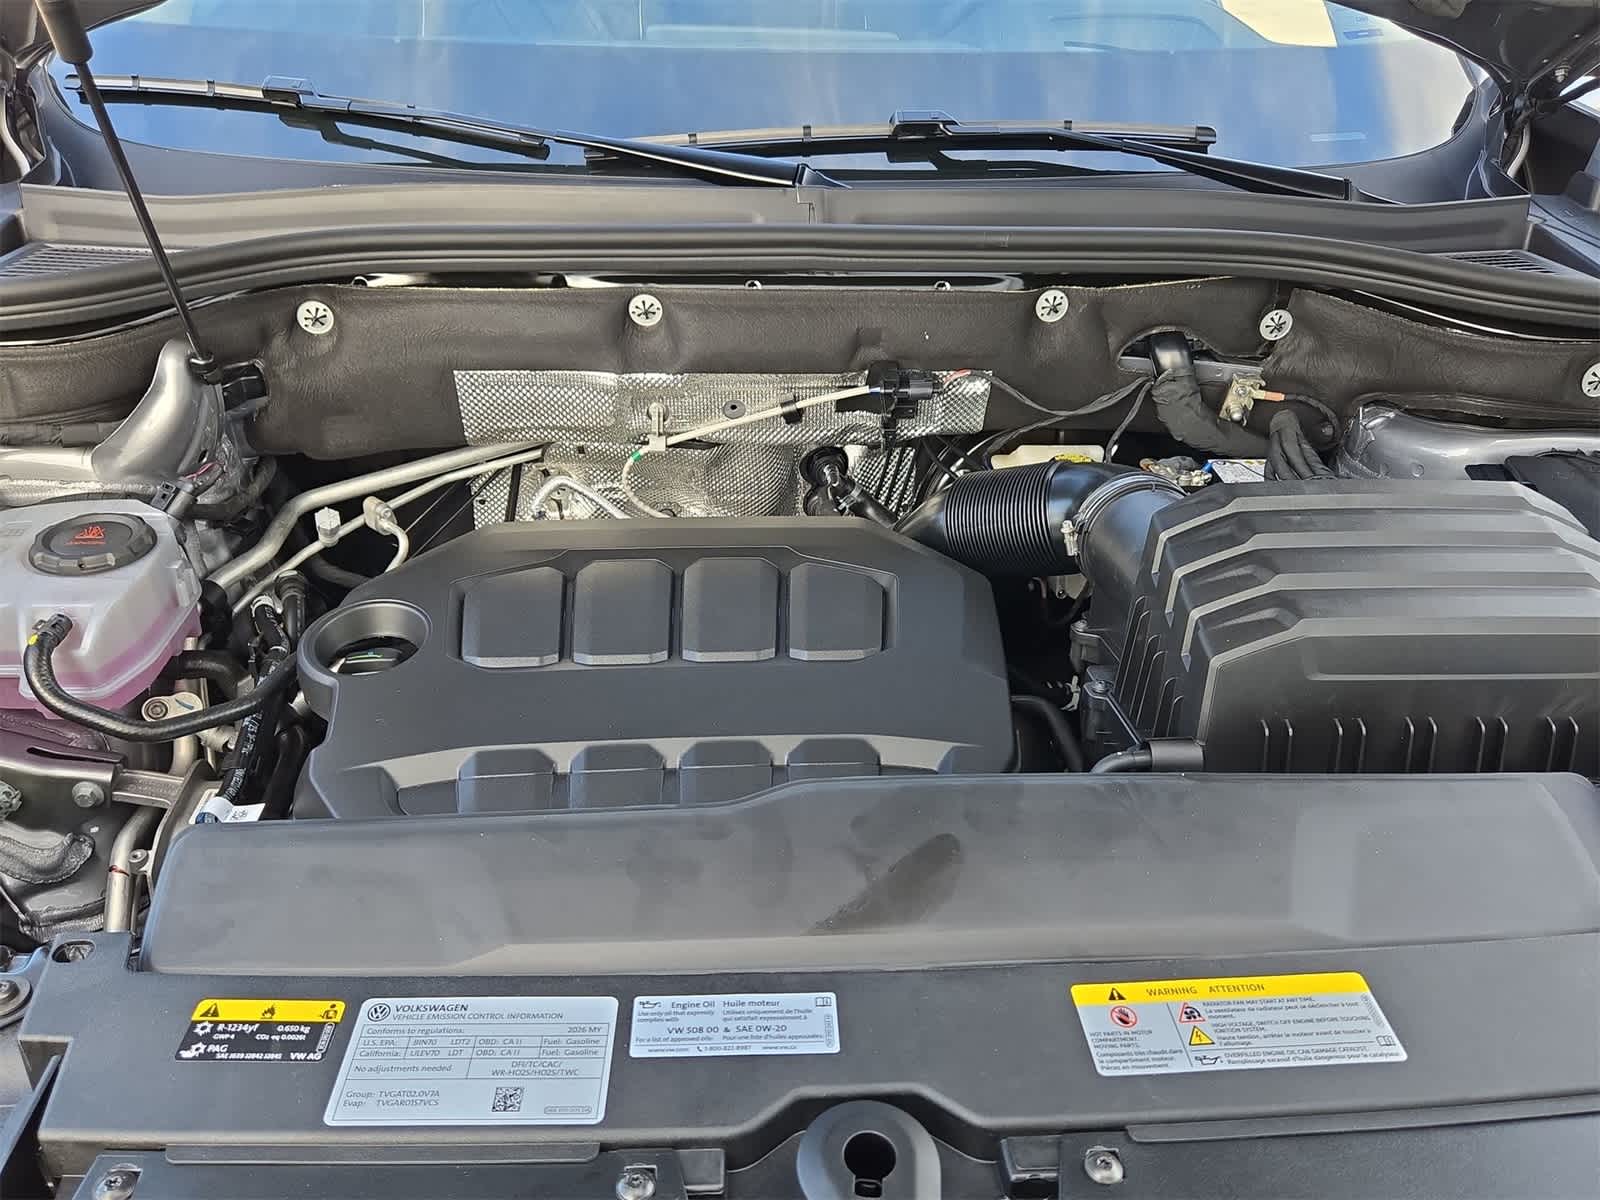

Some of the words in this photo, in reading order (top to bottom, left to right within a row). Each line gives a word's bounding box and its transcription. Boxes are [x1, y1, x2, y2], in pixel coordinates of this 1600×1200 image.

[1146, 986, 1197, 997] WARNING
[1208, 983, 1265, 994] ATTENTION
[395, 1003, 469, 1013] VOLKSWAGEN
[671, 1001, 701, 1010] Engine
[702, 1000, 716, 1008] Oil
[723, 1000, 746, 1008] Huile
[748, 999, 780, 1008] moteur
[392, 1013, 426, 1021] VEHICLE
[426, 1013, 465, 1021] EMISSION
[467, 1012, 504, 1020] CONTROL
[507, 1012, 563, 1020] INFORMATION
[216, 1023, 260, 1034] R-1234yf
[300, 1024, 311, 1034] kg
[366, 1026, 405, 1036] Conforms
[407, 1026, 415, 1035] to
[666, 1026, 684, 1034] VW
[735, 1025, 753, 1033] SAE
[755, 1024, 788, 1032] 0W-20
[413, 1038, 438, 1046] BIN70
[449, 1038, 472, 1046] LDT2
[206, 1043, 229, 1053] PAG
[448, 1049, 465, 1057] LDT
[564, 1048, 600, 1056] Gasoline
[289, 1052, 307, 1060] VW
[306, 1052, 322, 1060] AG
[353, 1065, 367, 1073] No
[368, 1064, 419, 1075] adjustments
[420, 1064, 453, 1073] needed
